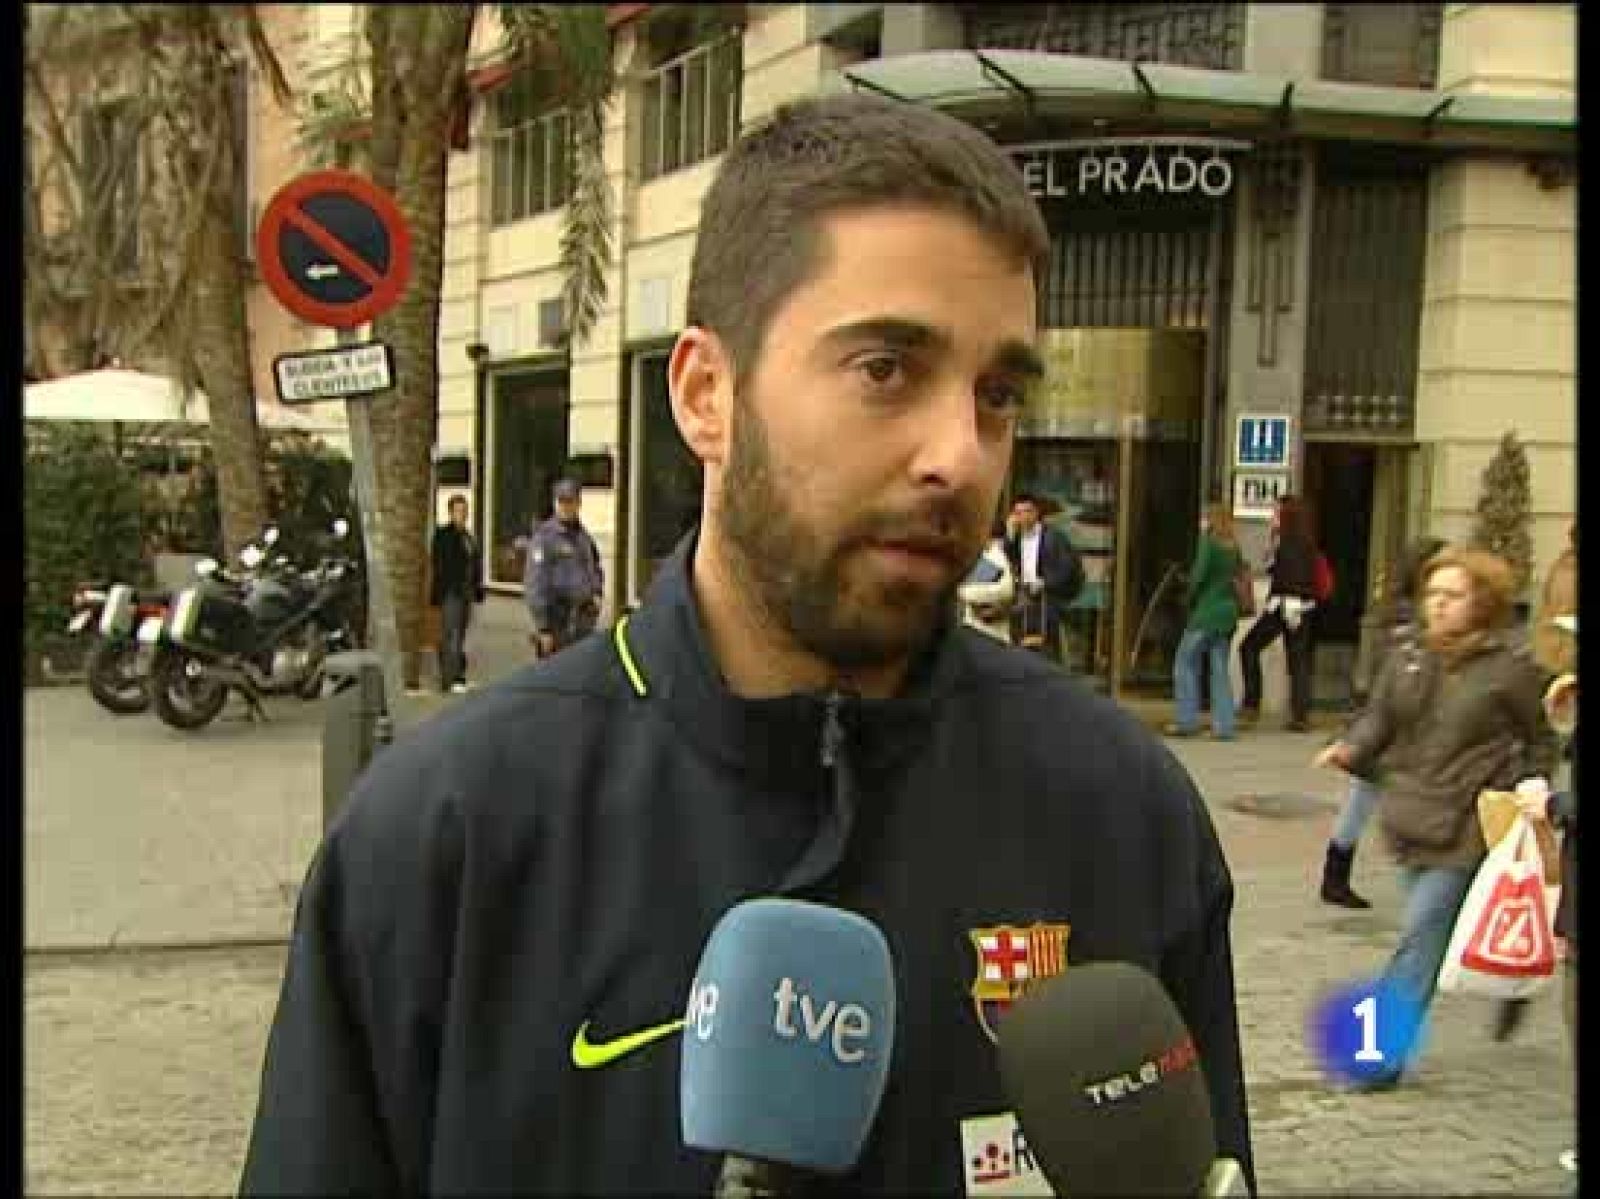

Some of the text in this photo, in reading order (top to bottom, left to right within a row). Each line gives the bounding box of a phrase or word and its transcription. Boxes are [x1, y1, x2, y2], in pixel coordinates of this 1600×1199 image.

[1024, 152, 1232, 196] EL PRADO
[773, 977, 871, 1063] tve
